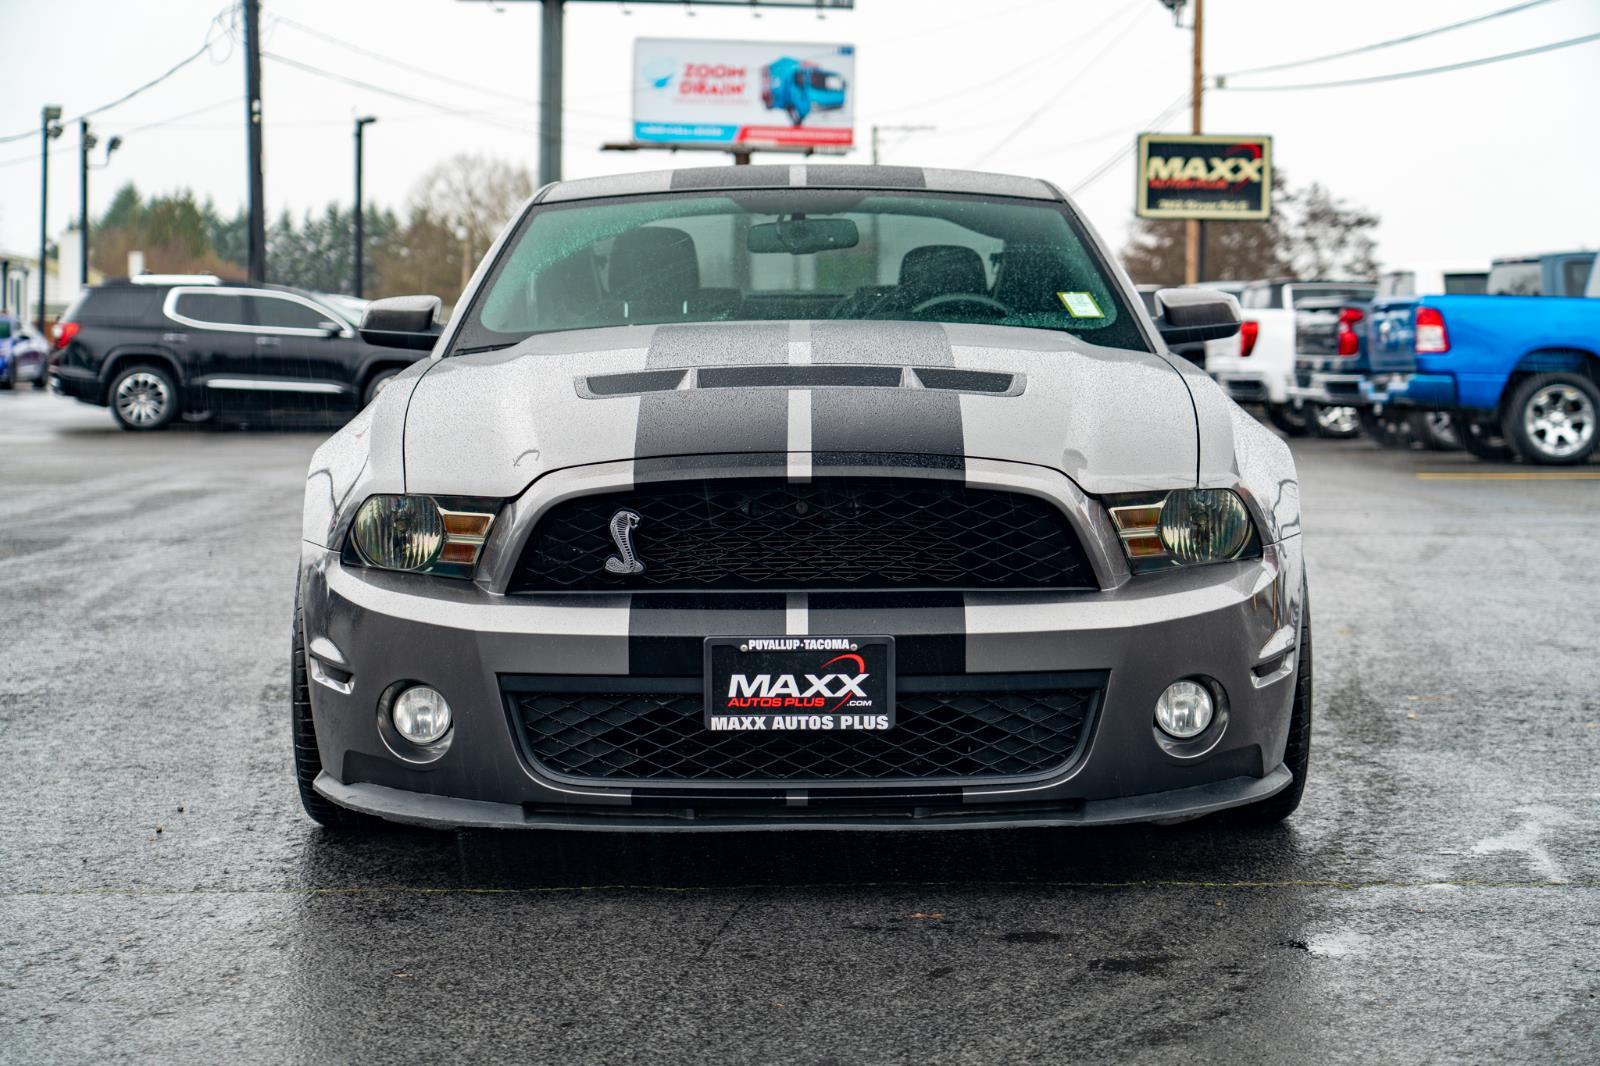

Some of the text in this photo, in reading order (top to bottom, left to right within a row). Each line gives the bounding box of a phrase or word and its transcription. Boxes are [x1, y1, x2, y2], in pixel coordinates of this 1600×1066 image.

[682, 63, 747, 78] ZOOM
[678, 80, 746, 95] DRAIN
[1148, 156, 1262, 182] MAXX
[727, 673, 870, 697] MAXX
[727, 697, 782, 708] AUTOS
[783, 697, 825, 707] PLUS
[710, 715, 889, 731] MAXX AUTOS PLUS
